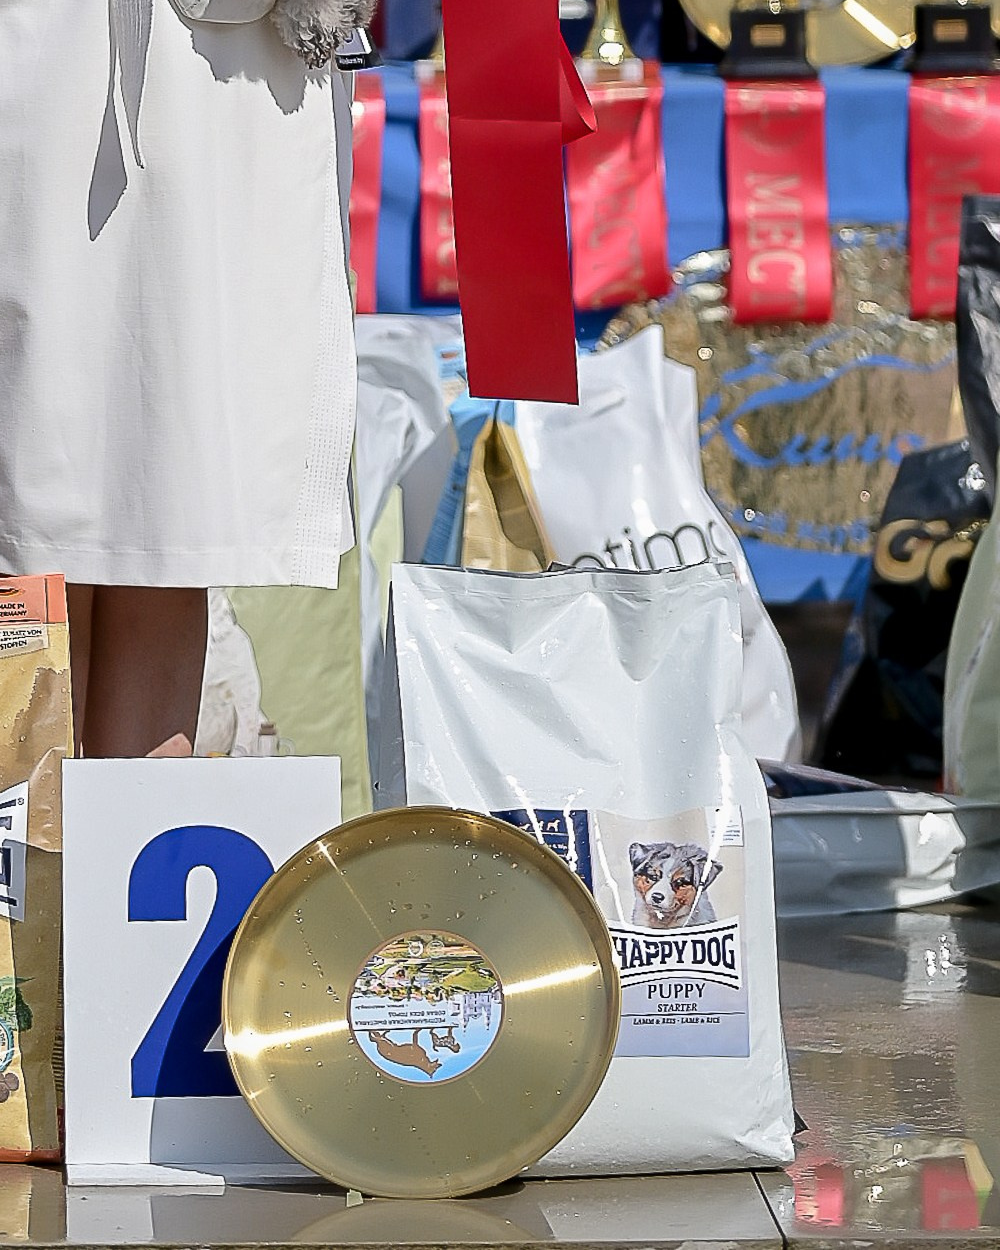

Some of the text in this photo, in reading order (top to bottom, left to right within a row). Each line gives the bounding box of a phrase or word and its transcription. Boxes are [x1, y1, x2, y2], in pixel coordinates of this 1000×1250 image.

[612, 934, 736, 970] HAPPY DOG
[127, 824, 277, 1098] 2
[648, 983, 706, 999] PUPPY
[657, 1003, 698, 1013] STARTER
[633, 1017, 654, 1025] LAMM
